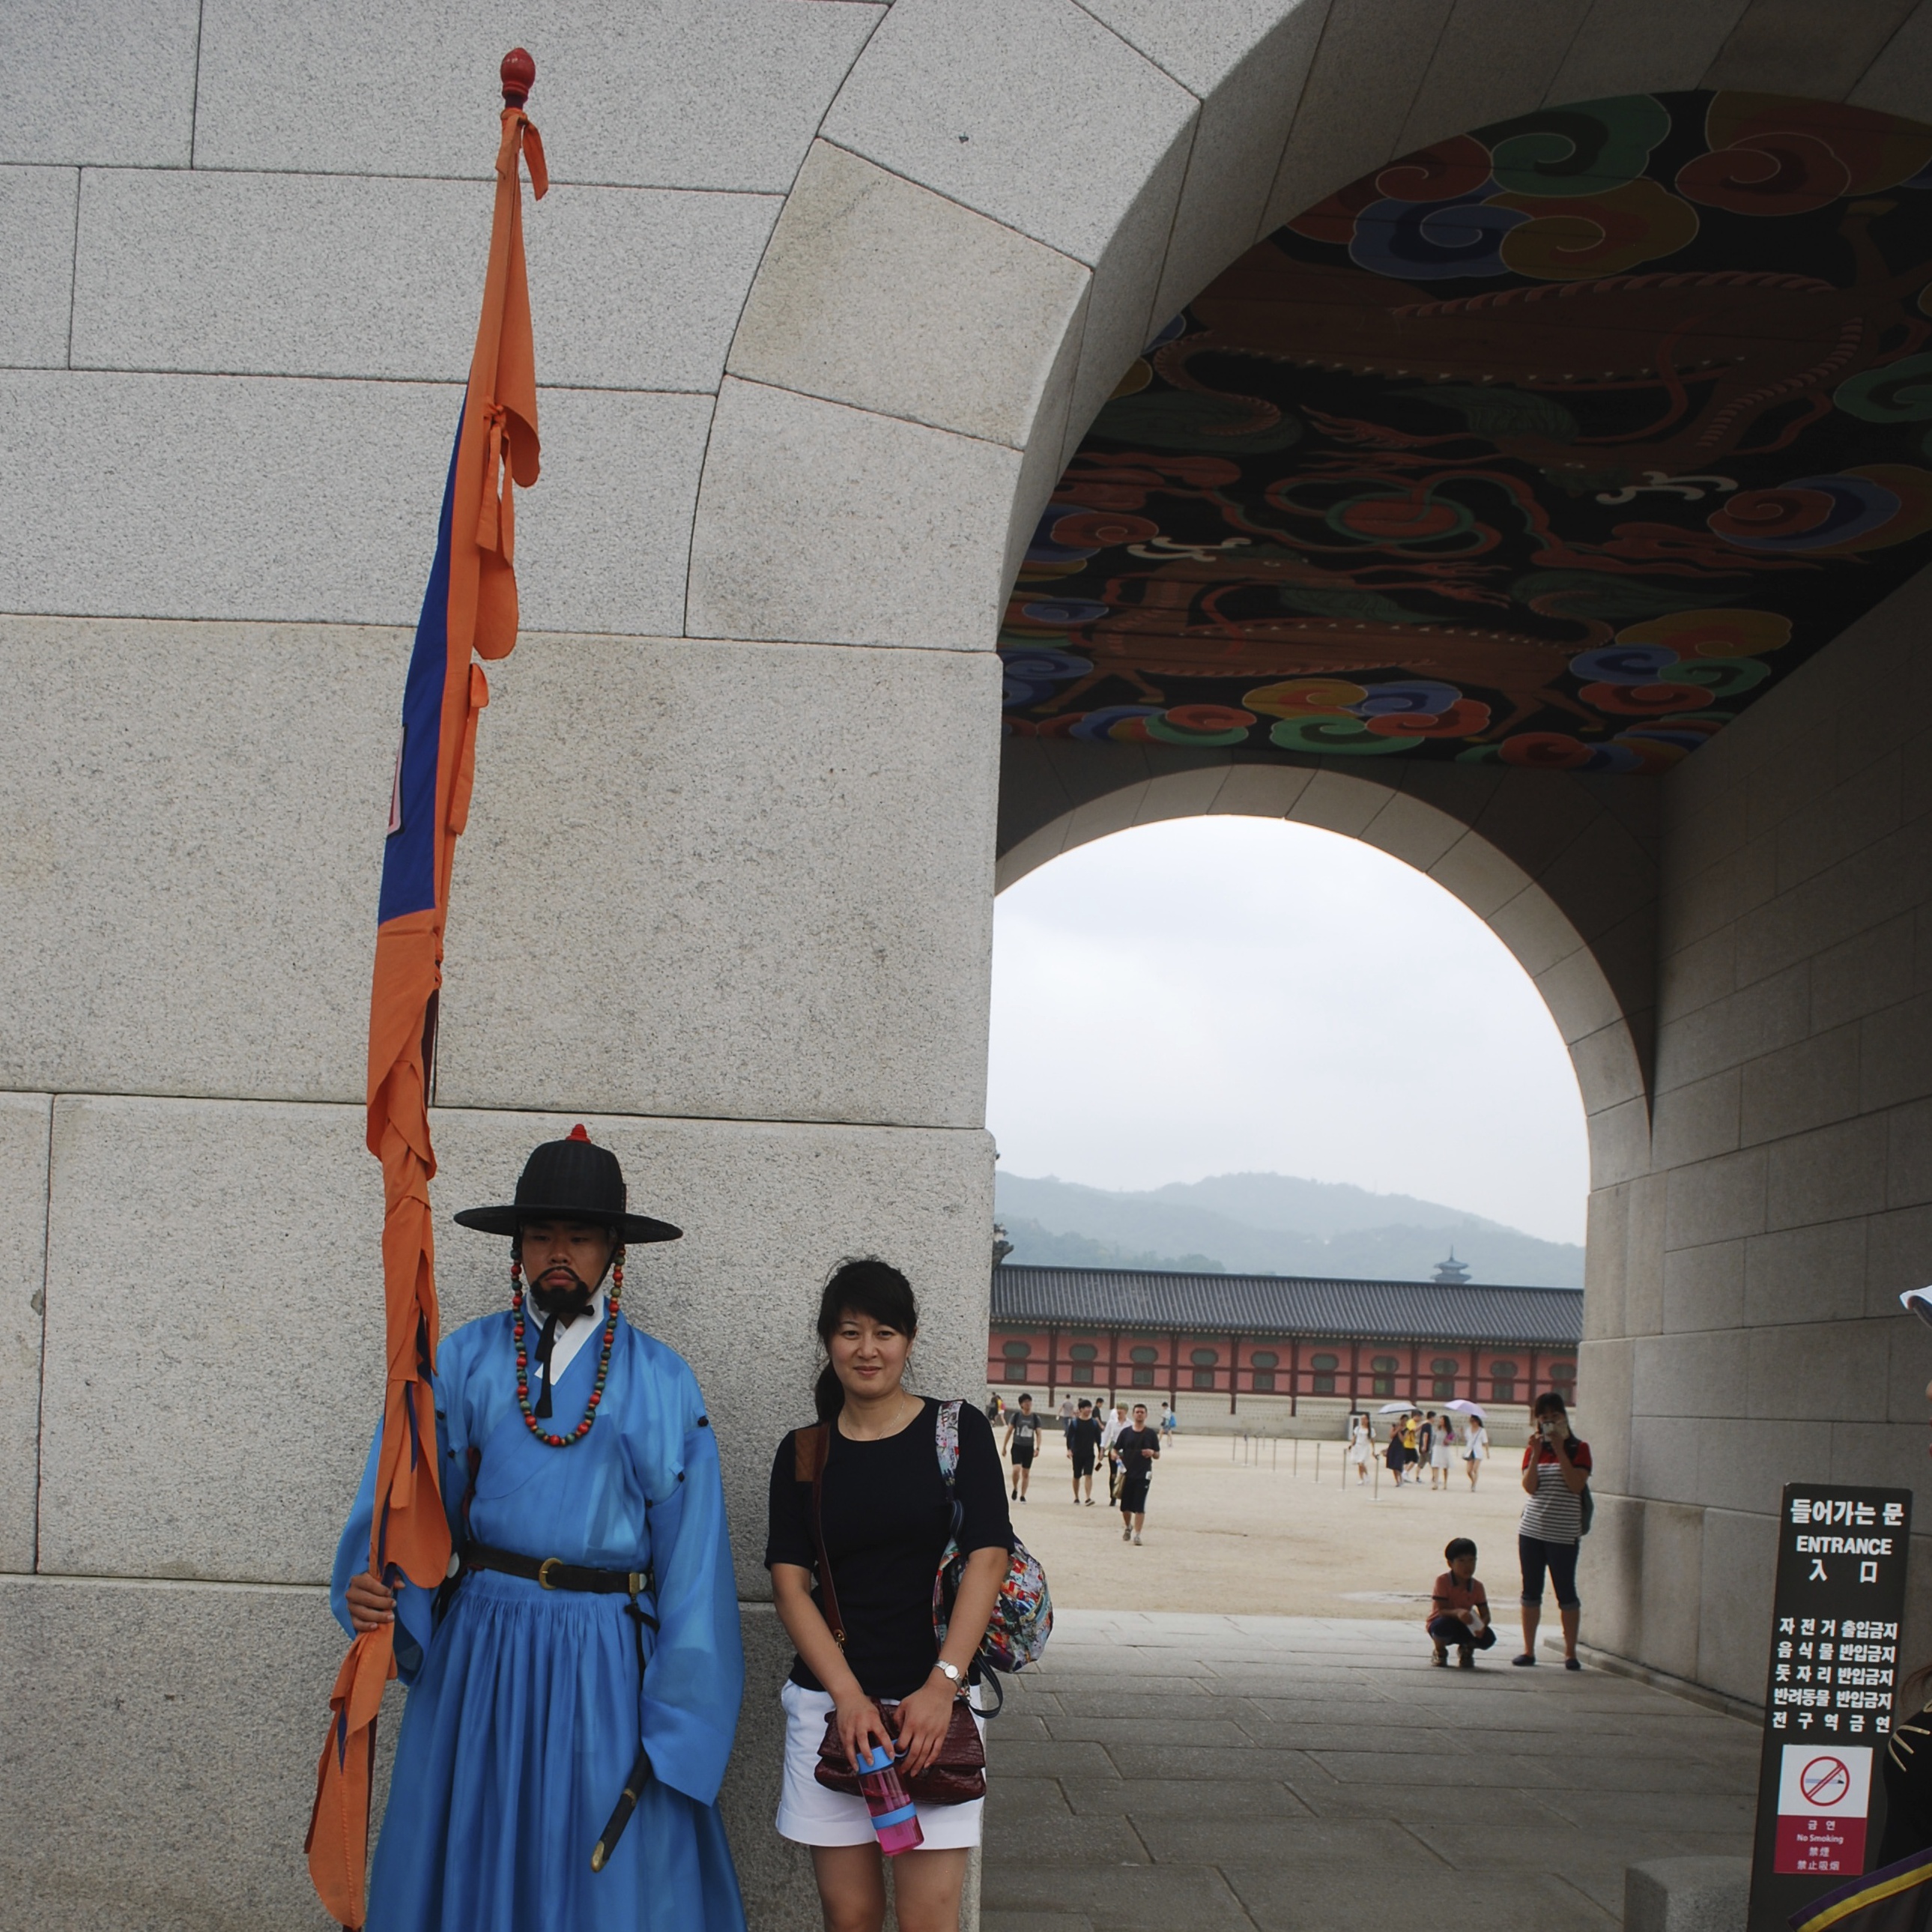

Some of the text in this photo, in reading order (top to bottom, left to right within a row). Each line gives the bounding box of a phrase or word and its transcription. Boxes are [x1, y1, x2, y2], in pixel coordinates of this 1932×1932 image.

[1790, 1499, 1904, 1526] 들어가는 문
[1796, 1536, 1892, 1554] ENTRANCE
[1841, 1620, 1898, 1640] 출입금지
[1839, 1644, 1896, 1663] 반입금지
[1838, 1668, 1894, 1686] 반입금지
[1774, 1688, 1892, 1710] 반려동물 반입금지
[1810, 1835, 1844, 1844] Smoking
